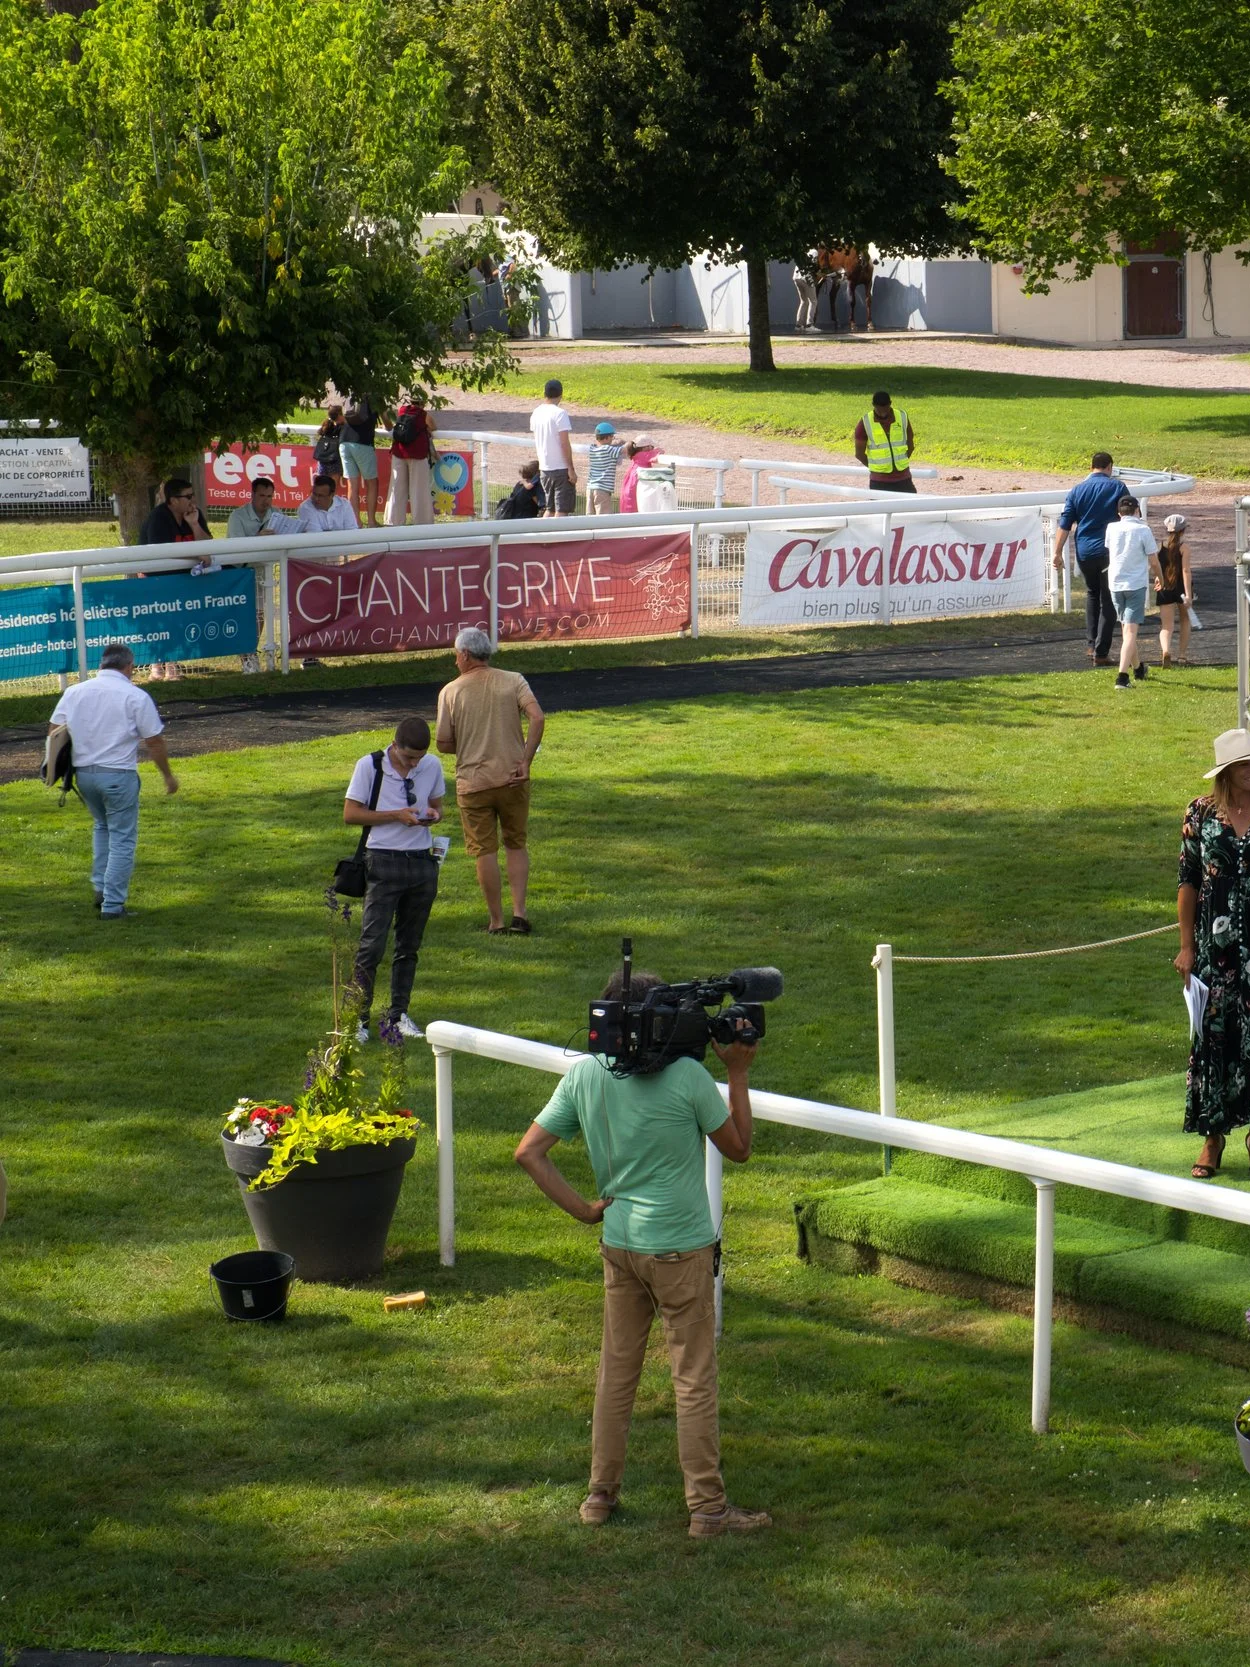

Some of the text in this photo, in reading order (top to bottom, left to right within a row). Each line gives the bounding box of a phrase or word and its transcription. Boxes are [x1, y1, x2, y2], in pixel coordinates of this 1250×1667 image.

[36, 448, 64, 456] VENTE
[0, 459, 73, 468] STION LOCATIVE
[13, 472, 25, 480] DE
[27, 469, 85, 480] COPROPRIÉTÉ
[208, 488, 236, 499] Teste
[768, 526, 1027, 593] Cavalassur
[296, 557, 615, 624] CHANTEGRIVE
[60, 604, 129, 622] hôelières
[132, 600, 182, 619] partout
[184, 598, 201, 611] en
[204, 593, 247, 608] France
[802, 599, 838, 618] bien
[844, 598, 880, 620] plus
[937, 592, 1008, 612] assureur
